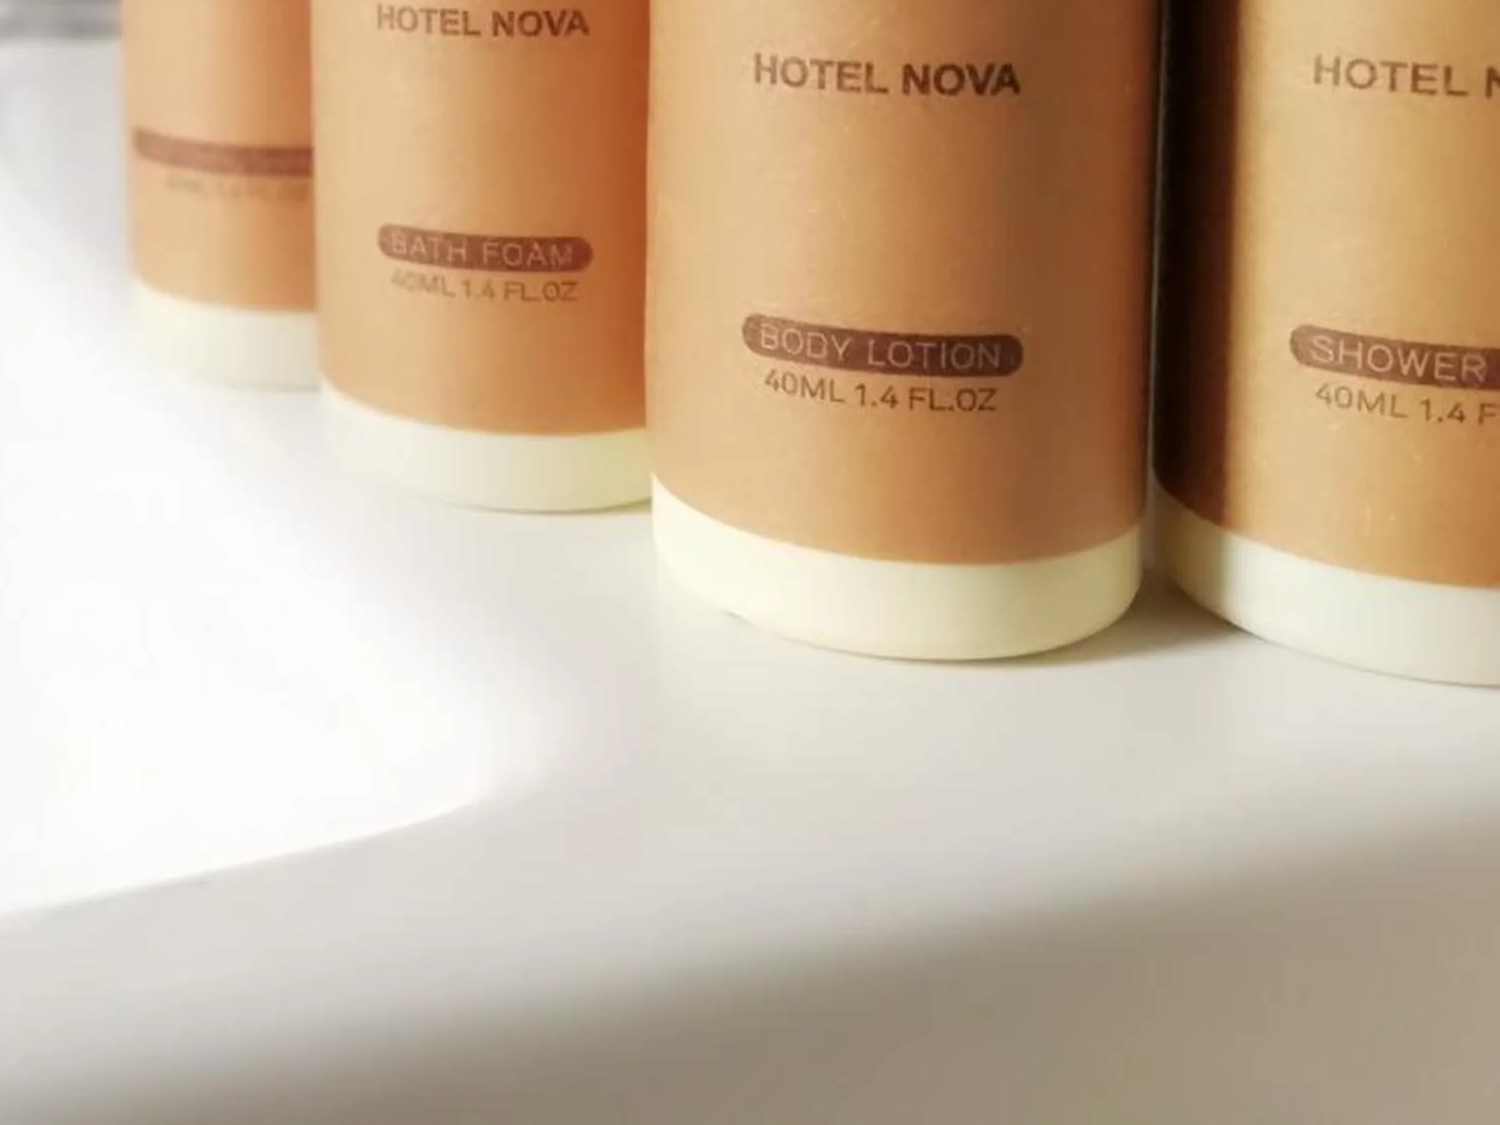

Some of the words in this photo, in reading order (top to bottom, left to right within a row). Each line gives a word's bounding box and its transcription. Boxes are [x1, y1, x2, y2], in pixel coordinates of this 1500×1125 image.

[377, 4, 482, 37] HOTEL
[492, 10, 590, 37] NOVA
[754, 53, 890, 94] HOTEL
[901, 63, 1021, 95] NOVA
[1313, 54, 1469, 97] HOTEL
[389, 233, 468, 262] BATH
[482, 241, 574, 267] FOAM
[759, 323, 852, 362] BODY
[867, 339, 1001, 369] LOTION
[1310, 335, 1487, 383] SHOWER
[764, 369, 846, 404] 40ML
[854, 384, 899, 409] 1.4
[908, 387, 998, 412] FL.OZ
[1315, 383, 1409, 419] 40ML
[1420, 398, 1466, 424] 1.4
